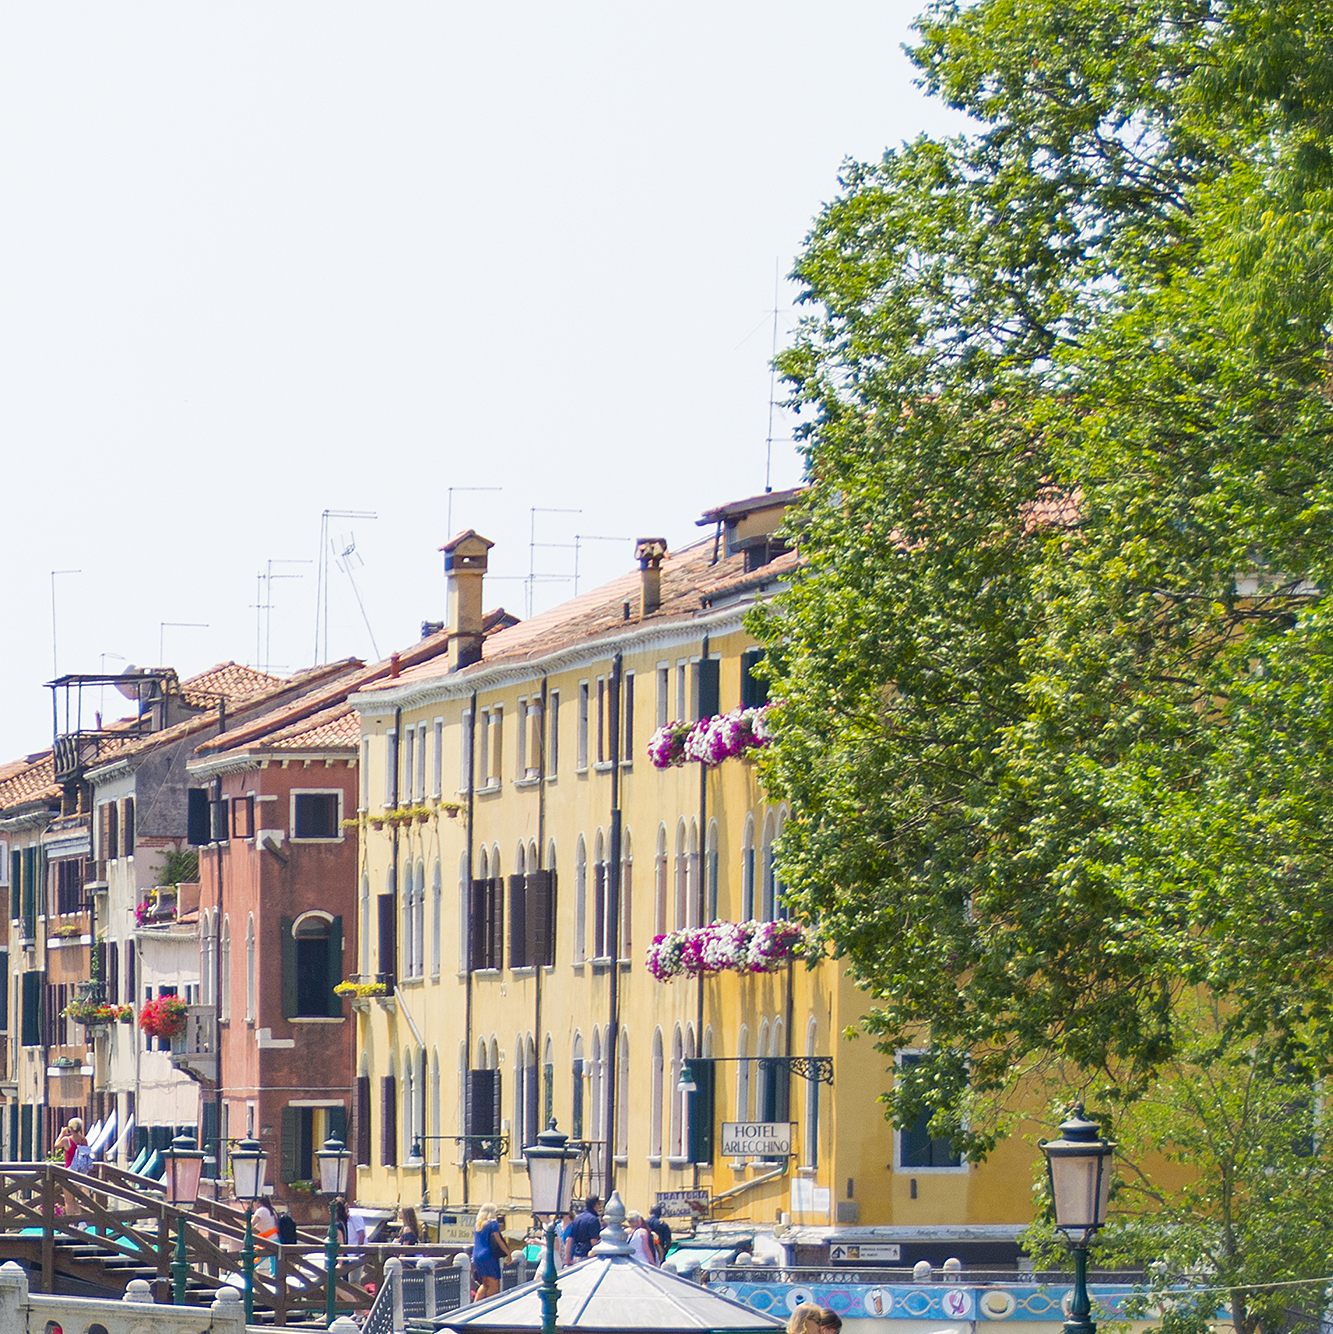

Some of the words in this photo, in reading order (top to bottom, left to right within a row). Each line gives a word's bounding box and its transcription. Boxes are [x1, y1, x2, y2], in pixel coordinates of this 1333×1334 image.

[735, 1125, 778, 1138] HOTEL
[724, 1140, 789, 1153] ARLECCHINO
[657, 1191, 708, 1201] TRATTORIA
